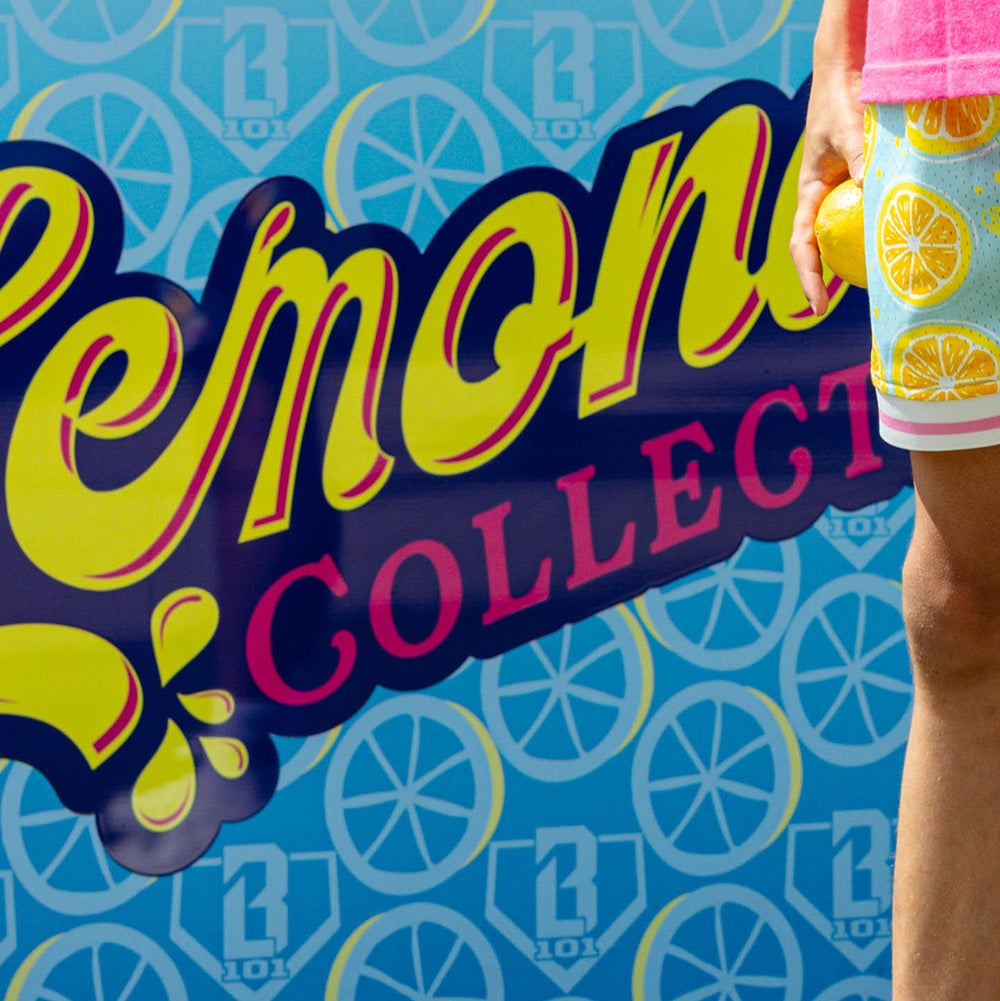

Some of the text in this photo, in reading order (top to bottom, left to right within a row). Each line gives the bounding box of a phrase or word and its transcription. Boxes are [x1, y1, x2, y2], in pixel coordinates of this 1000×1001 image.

[222, 118, 289, 139] 101
[532, 119, 596, 140] 101
[0, 103, 852, 592] emon
[828, 515, 892, 539] 101
[832, 918, 892, 940] 101
[535, 937, 599, 960] 101
[222, 957, 289, 981] 101
